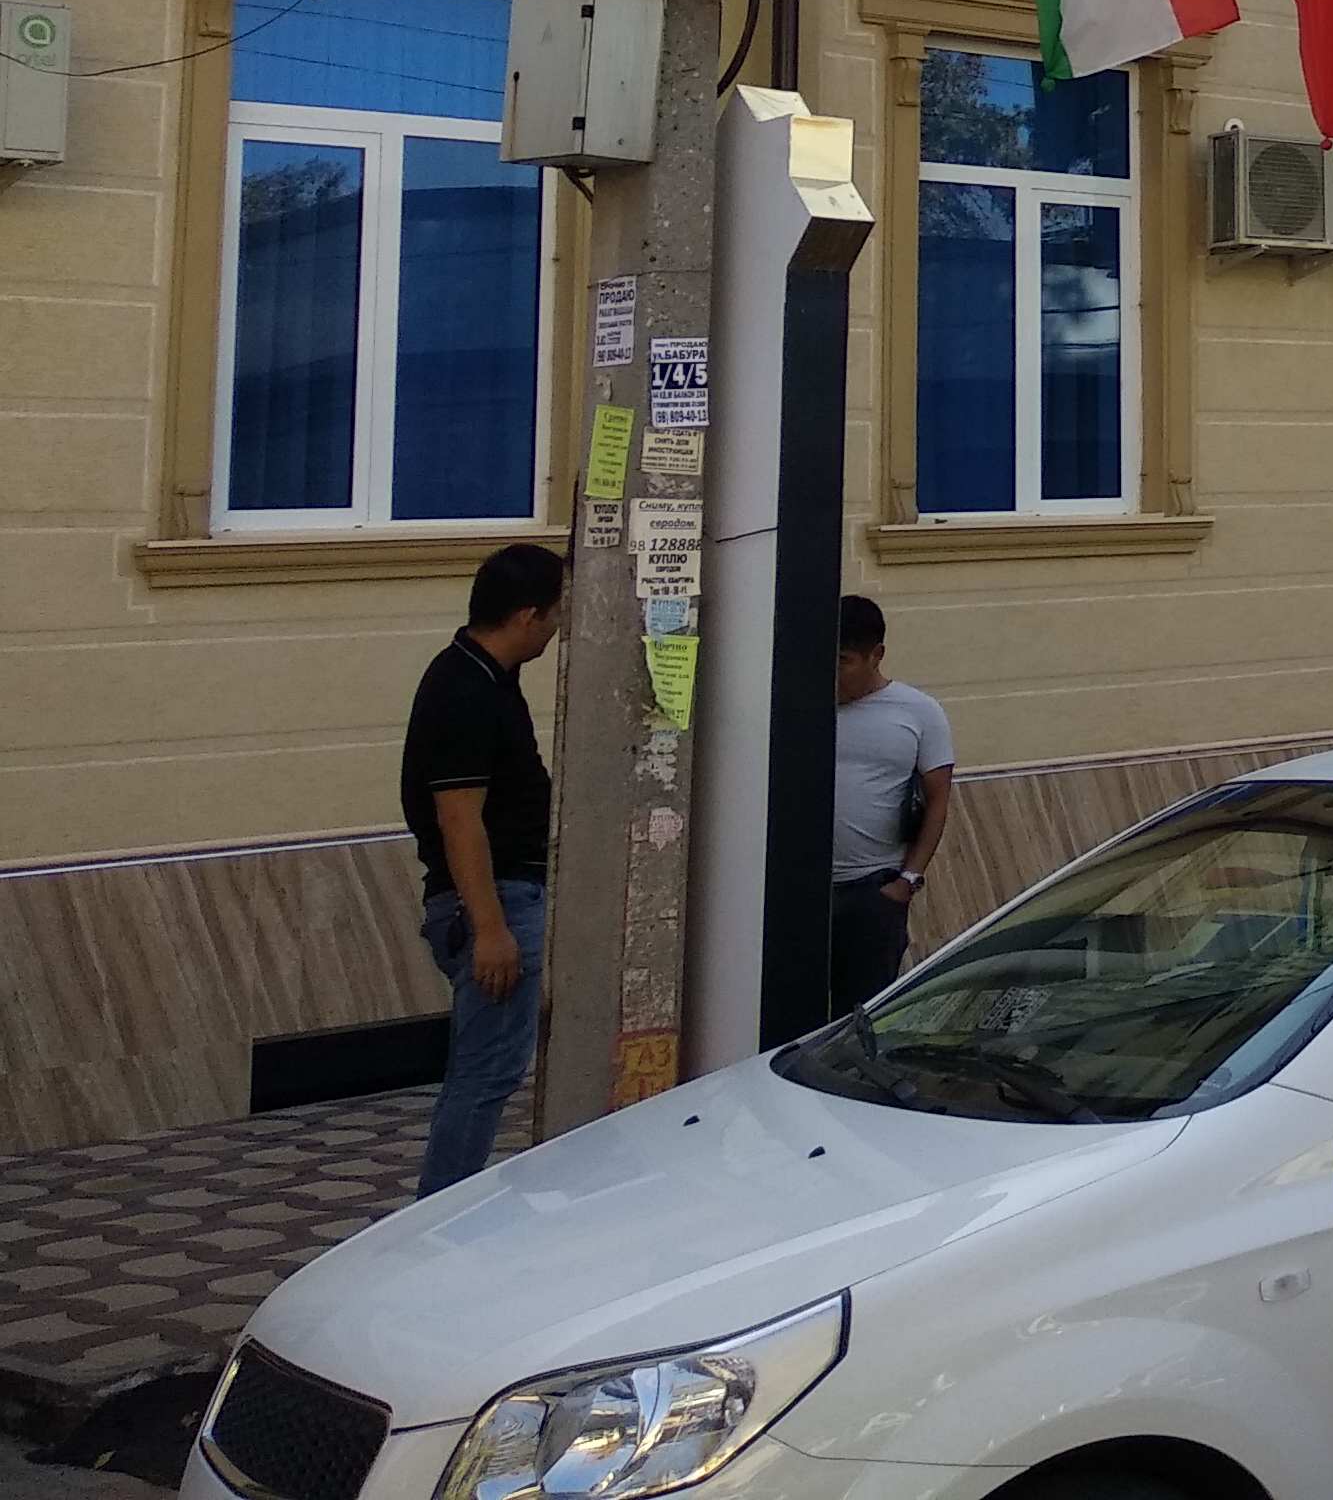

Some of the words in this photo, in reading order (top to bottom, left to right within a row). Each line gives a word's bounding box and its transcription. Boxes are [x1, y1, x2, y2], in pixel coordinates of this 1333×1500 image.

[599, 289, 635, 305] ПРОДАЮ
[652, 363, 708, 390] 1/4/5
[629, 540, 646, 552] 98
[648, 553, 688, 564] КУПЛЮ
